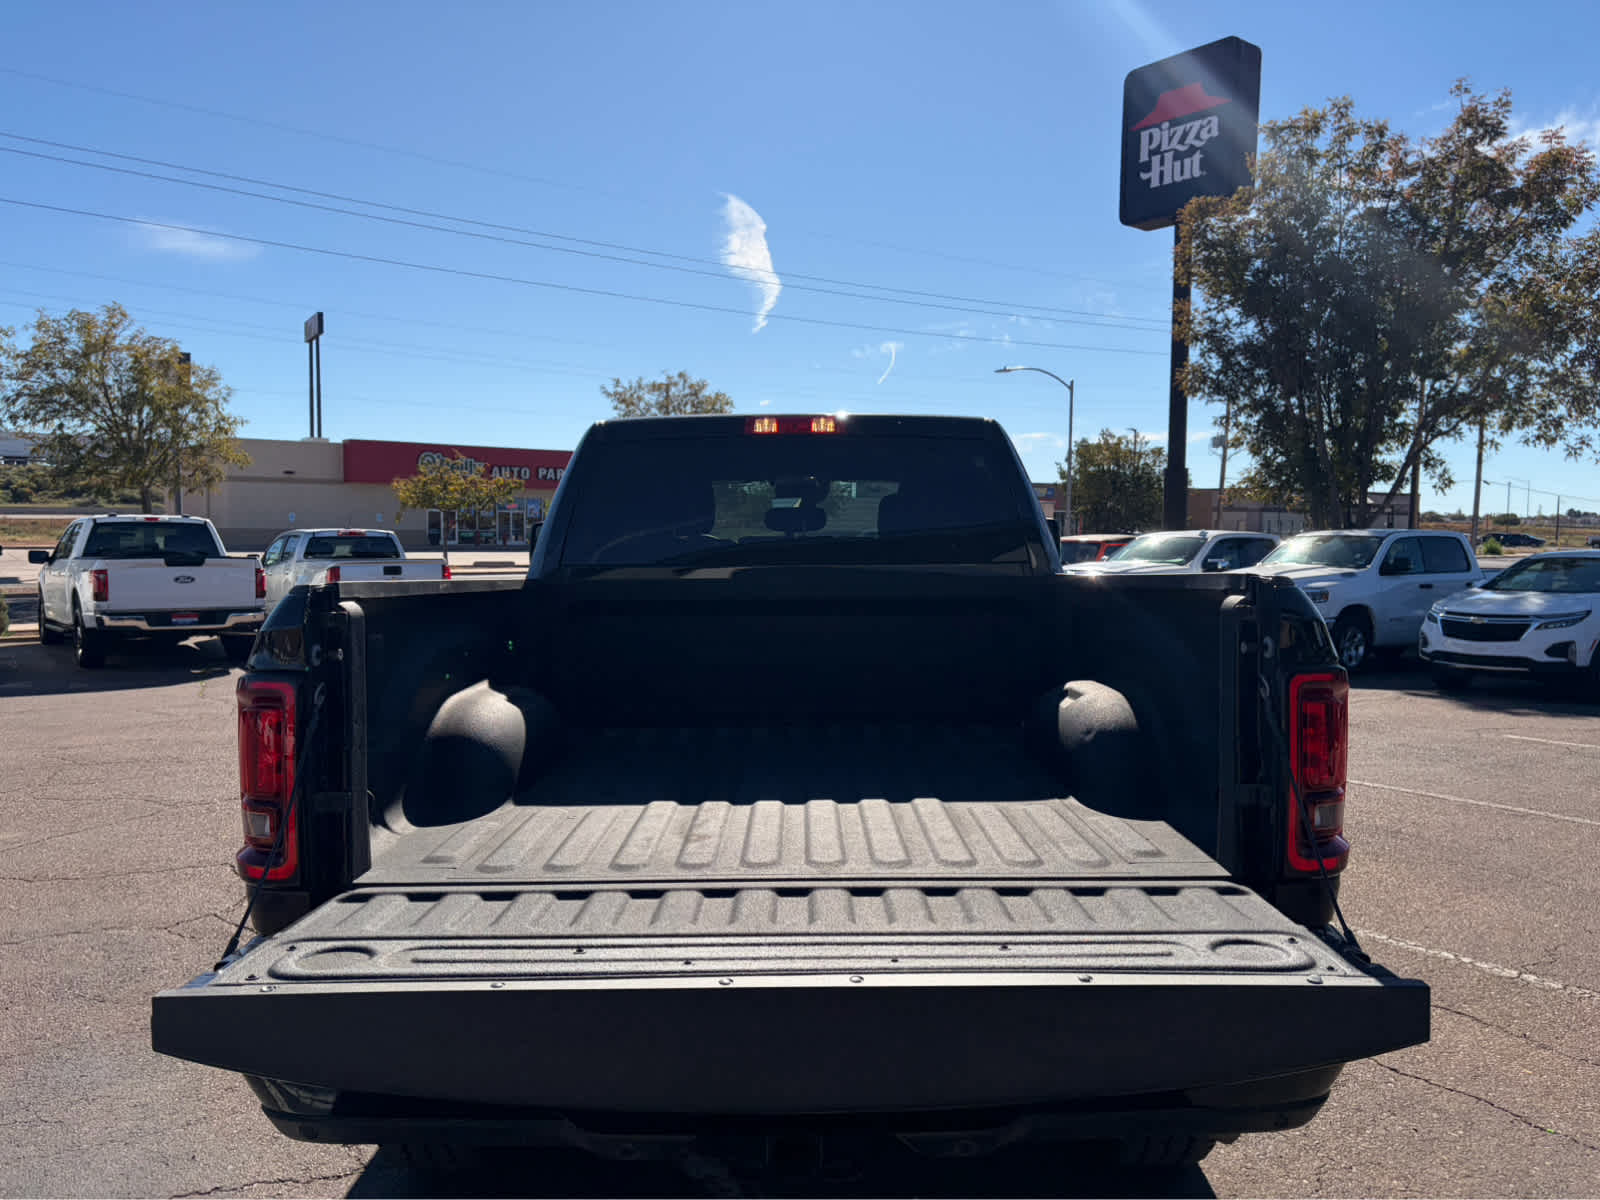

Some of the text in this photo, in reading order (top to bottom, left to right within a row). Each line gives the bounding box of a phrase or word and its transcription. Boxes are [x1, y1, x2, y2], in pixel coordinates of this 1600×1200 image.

[1139, 116, 1219, 163] Pizza
[1140, 150, 1204, 188] Hut
[492, 466, 530, 479] AUTO
